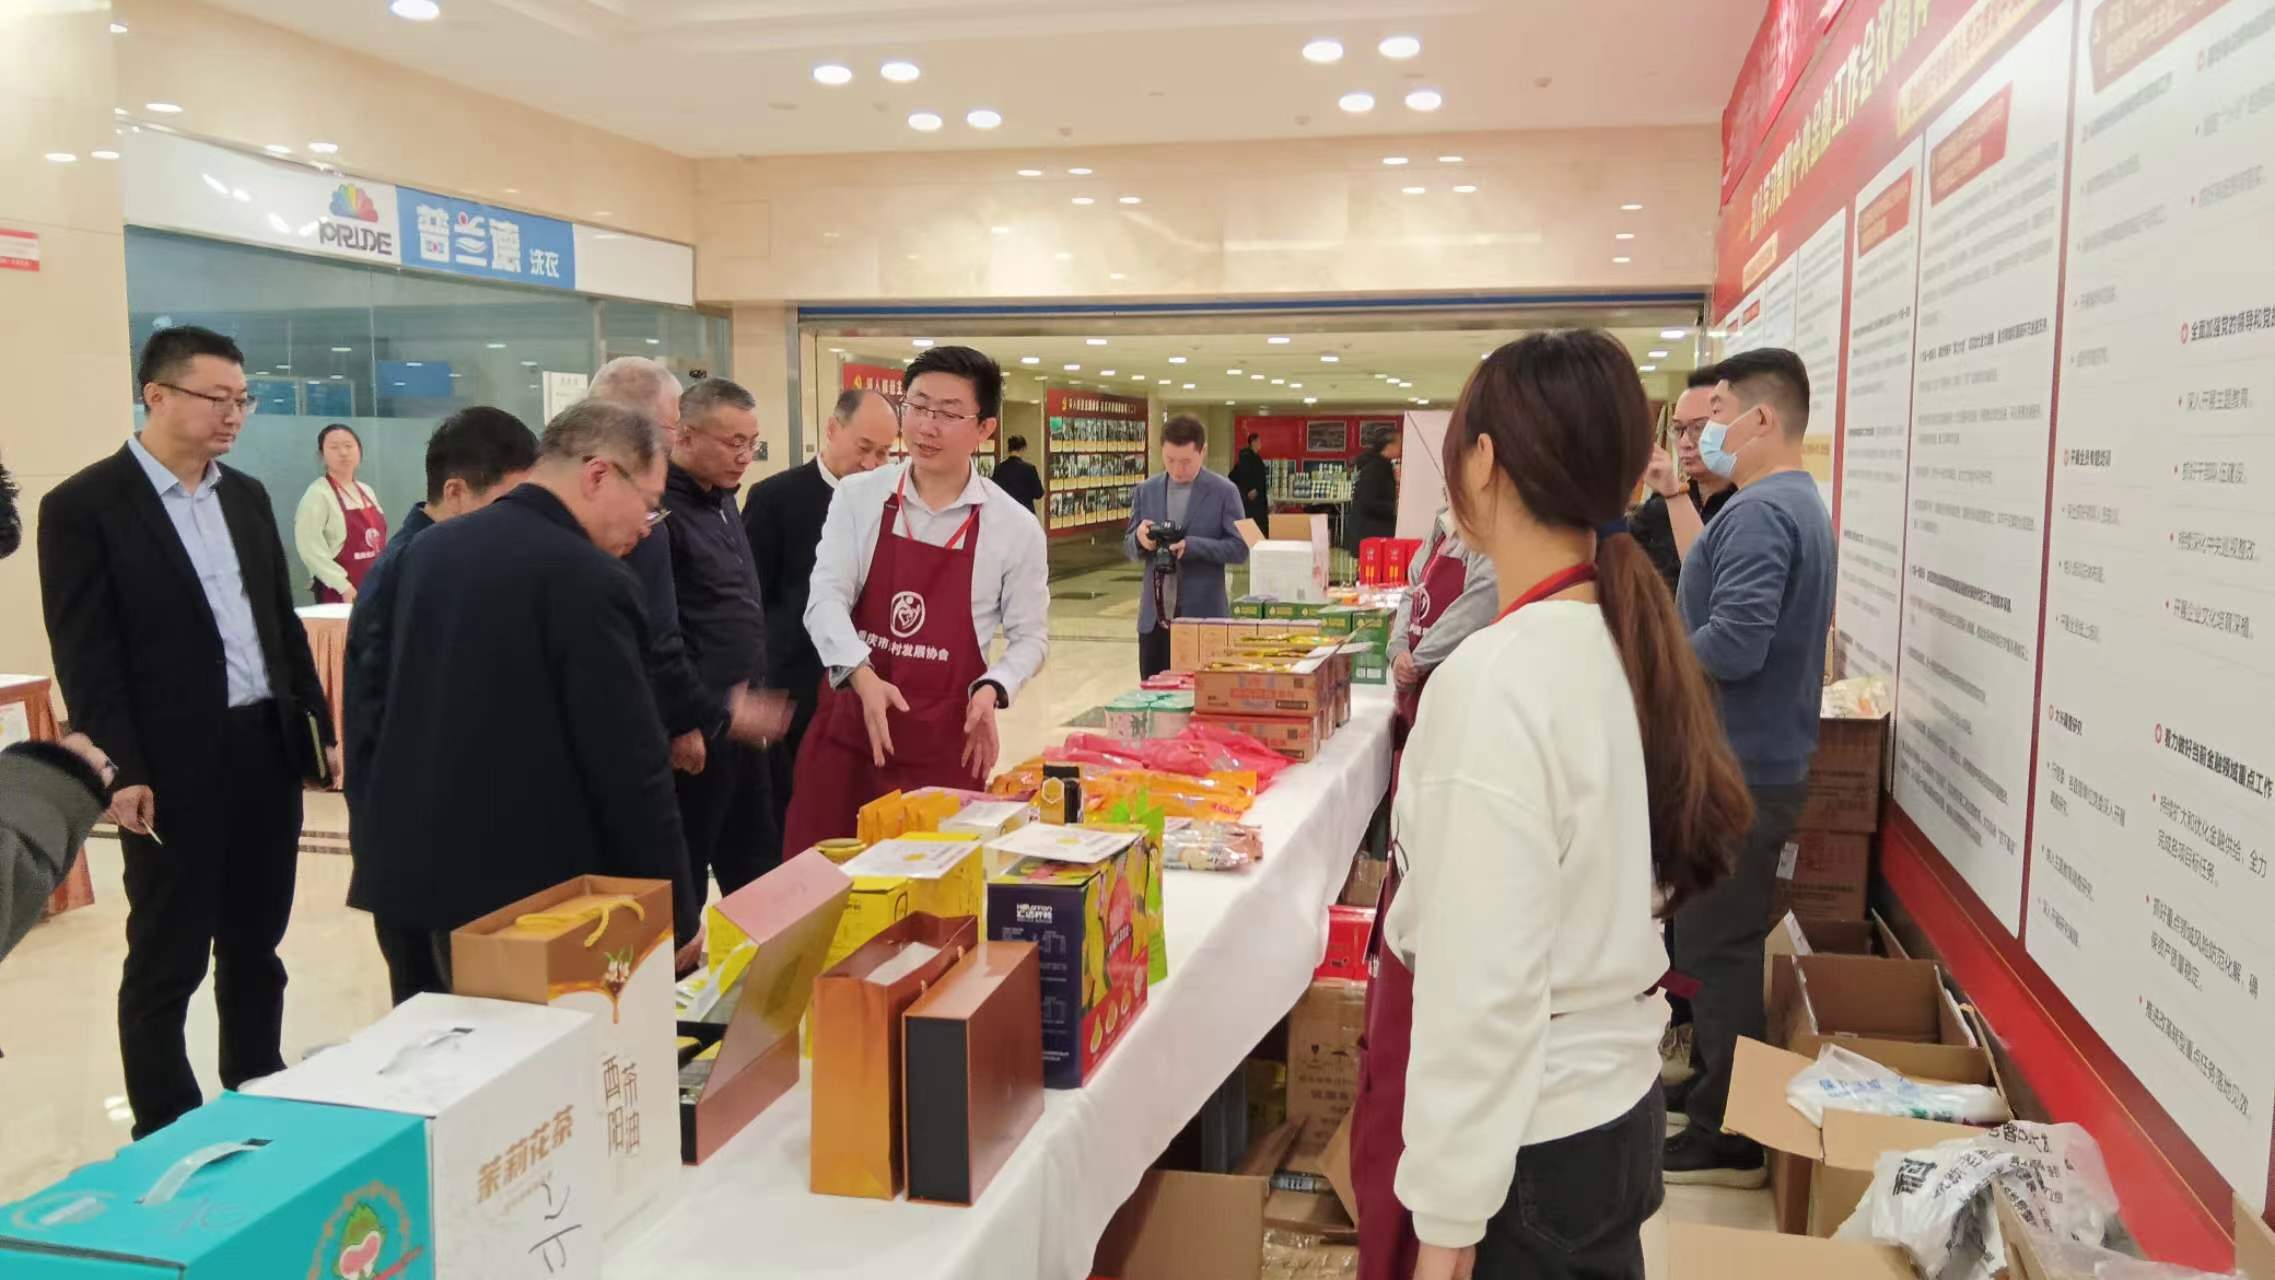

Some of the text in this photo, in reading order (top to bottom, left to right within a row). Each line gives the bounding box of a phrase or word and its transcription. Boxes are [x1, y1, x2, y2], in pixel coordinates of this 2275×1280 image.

[318, 221, 392, 255] PRIDE
[416, 204, 560, 278] 普兰德 洗衣
[858, 630, 949, 661] 重庆市村发展协会
[2164, 727, 2273, 800] 着力做好当前金融领域重点工作
[477, 1104, 574, 1204] 茉莉花茶
